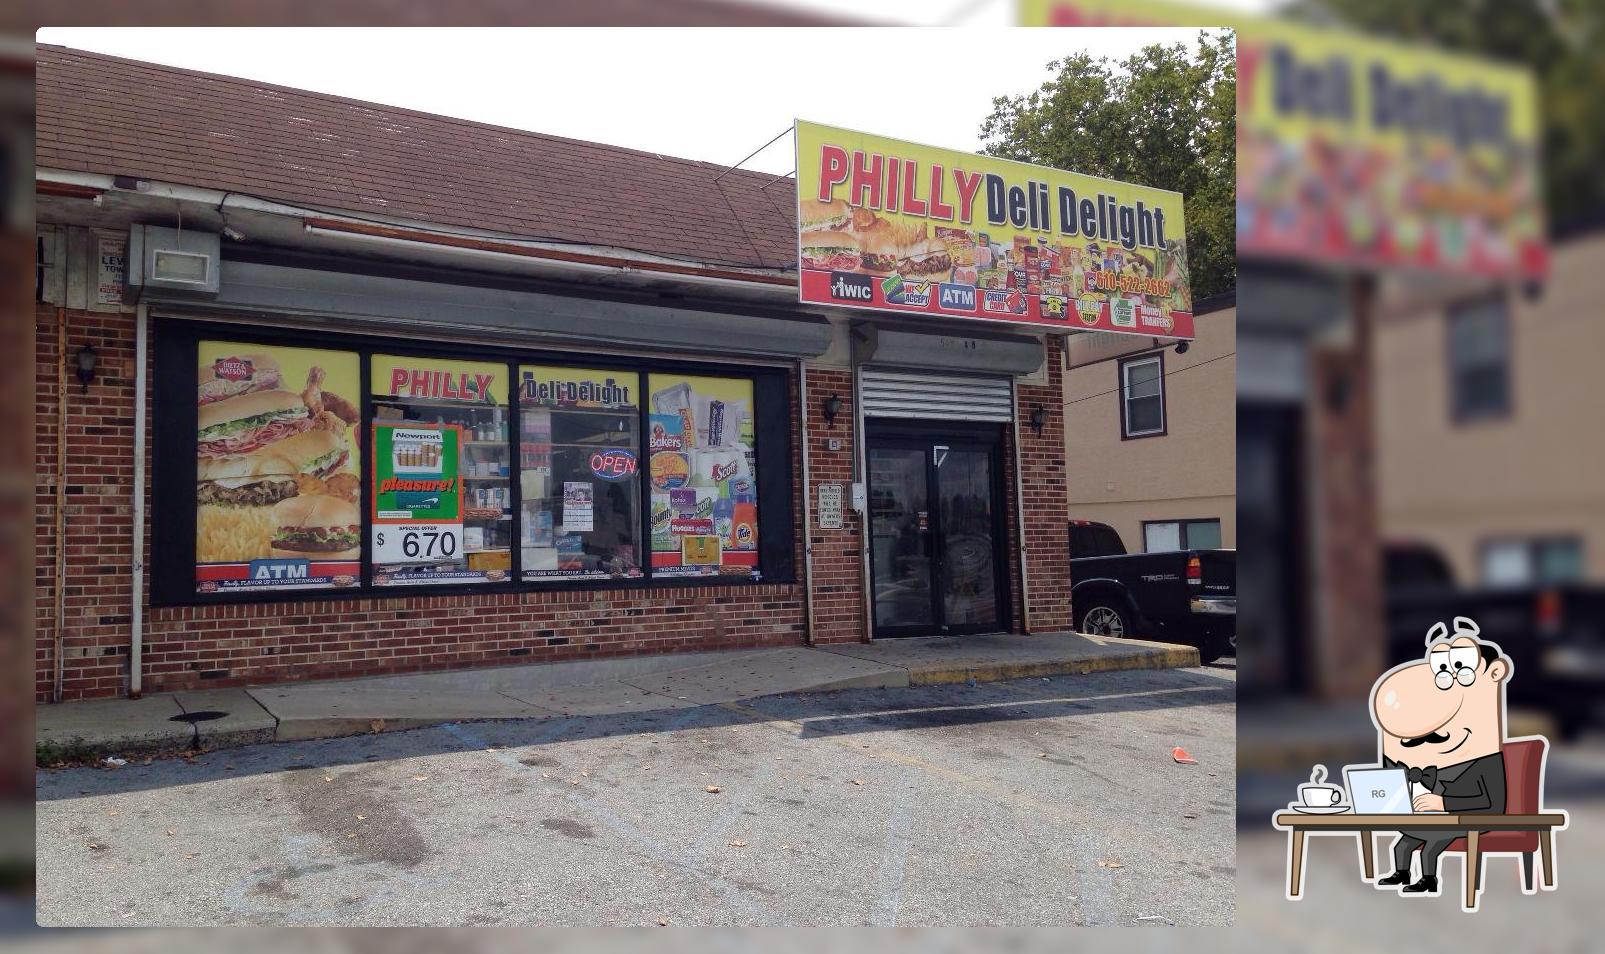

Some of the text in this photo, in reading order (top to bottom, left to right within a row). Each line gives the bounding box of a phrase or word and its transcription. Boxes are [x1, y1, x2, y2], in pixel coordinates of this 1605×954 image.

[818, 143, 1167, 251] PHILLY Deli Delight
[905, 294, 929, 305] ACCEPT
[942, 288, 974, 305] ATM
[218, 367, 247, 376] WATSON
[390, 367, 496, 401] PHILLY
[526, 378, 629, 404] Deli Delight
[395, 431, 441, 441] Newport
[591, 454, 637, 474] OPEN
[716, 461, 737, 481] Scott
[379, 476, 455, 495] pleasure!
[696, 497, 712, 514] cott
[376, 532, 385, 547] $
[737, 530, 751, 539] Tide
[255, 565, 307, 580] ATM
